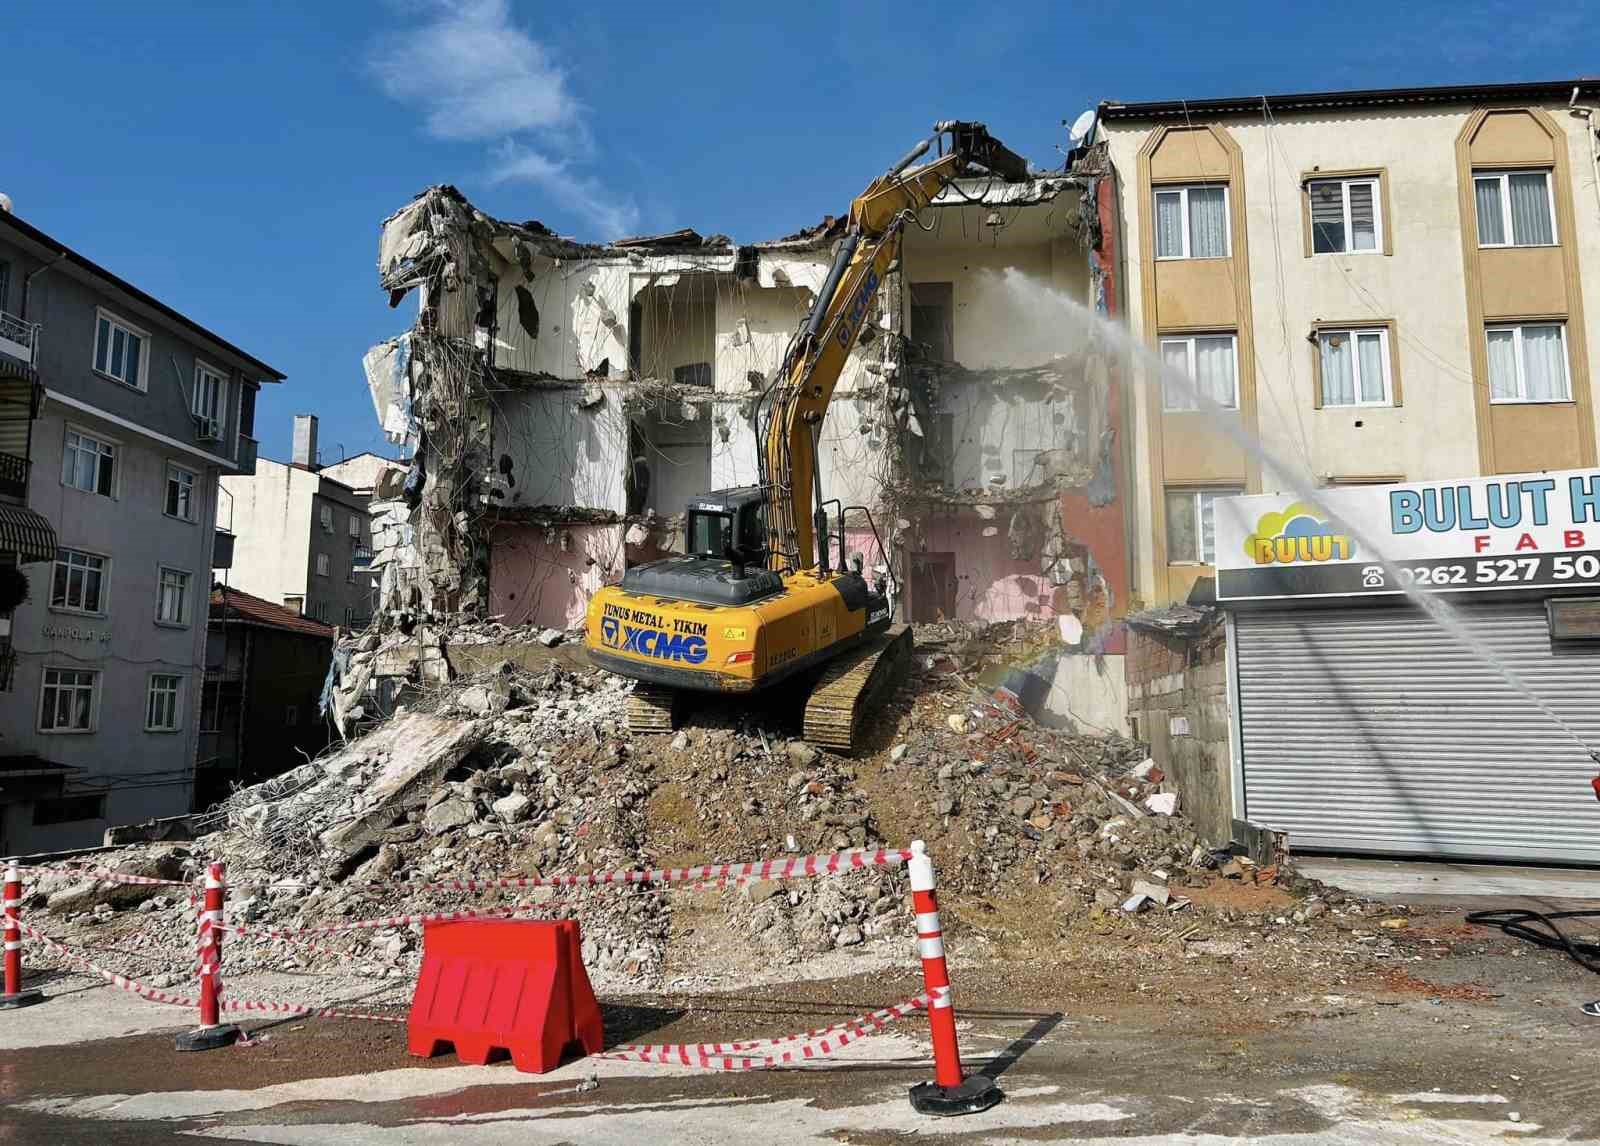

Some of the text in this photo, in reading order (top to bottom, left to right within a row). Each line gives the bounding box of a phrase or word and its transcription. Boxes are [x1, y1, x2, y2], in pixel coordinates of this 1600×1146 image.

[1389, 478, 1556, 535] BULUT
[1254, 534, 1350, 565] BULUT
[1400, 554, 1600, 586] 0262 527 50
[603, 603, 631, 621] YUNUS
[631, 609, 664, 629] METAL
[673, 618, 708, 636] YIKIM
[621, 625, 708, 665] XCMG
